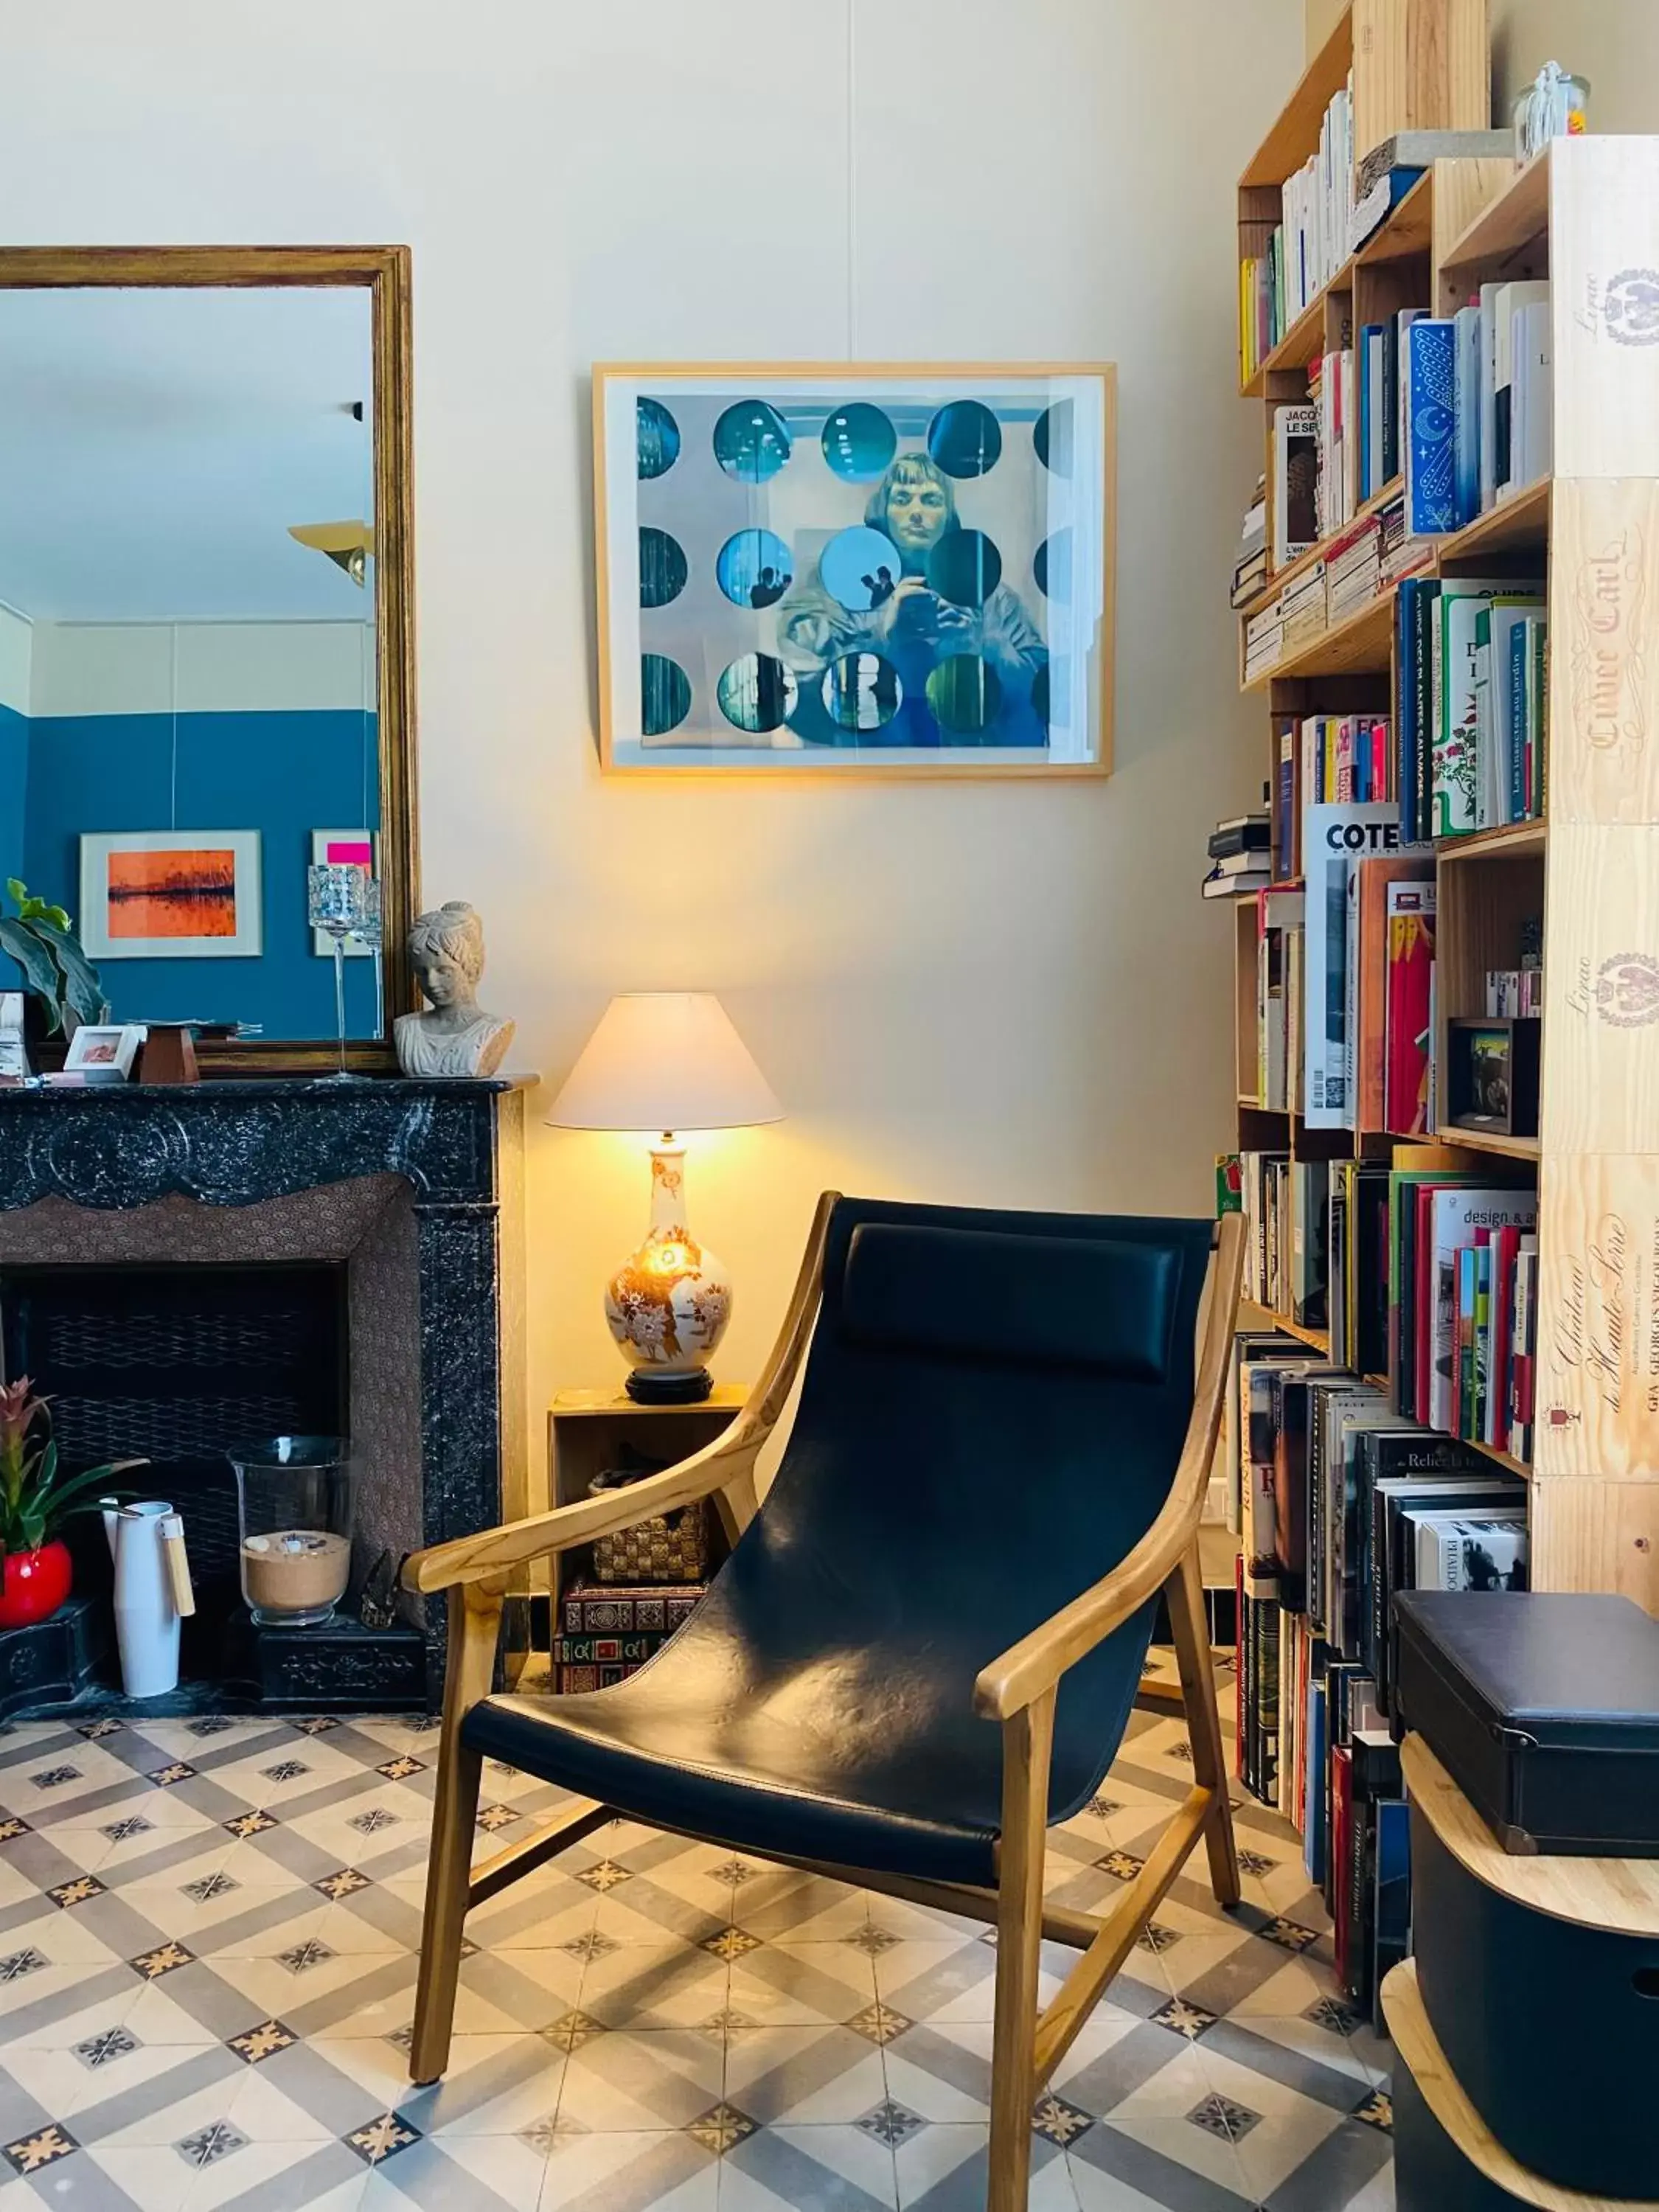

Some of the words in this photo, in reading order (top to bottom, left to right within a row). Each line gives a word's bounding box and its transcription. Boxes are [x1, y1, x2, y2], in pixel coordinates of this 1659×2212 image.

[1512, 653, 1520, 693] jardin
[1464, 1208, 1508, 1228] design
[1648, 1307, 1659, 1376] GEORGES
[1601, 1389, 1621, 1413] de
